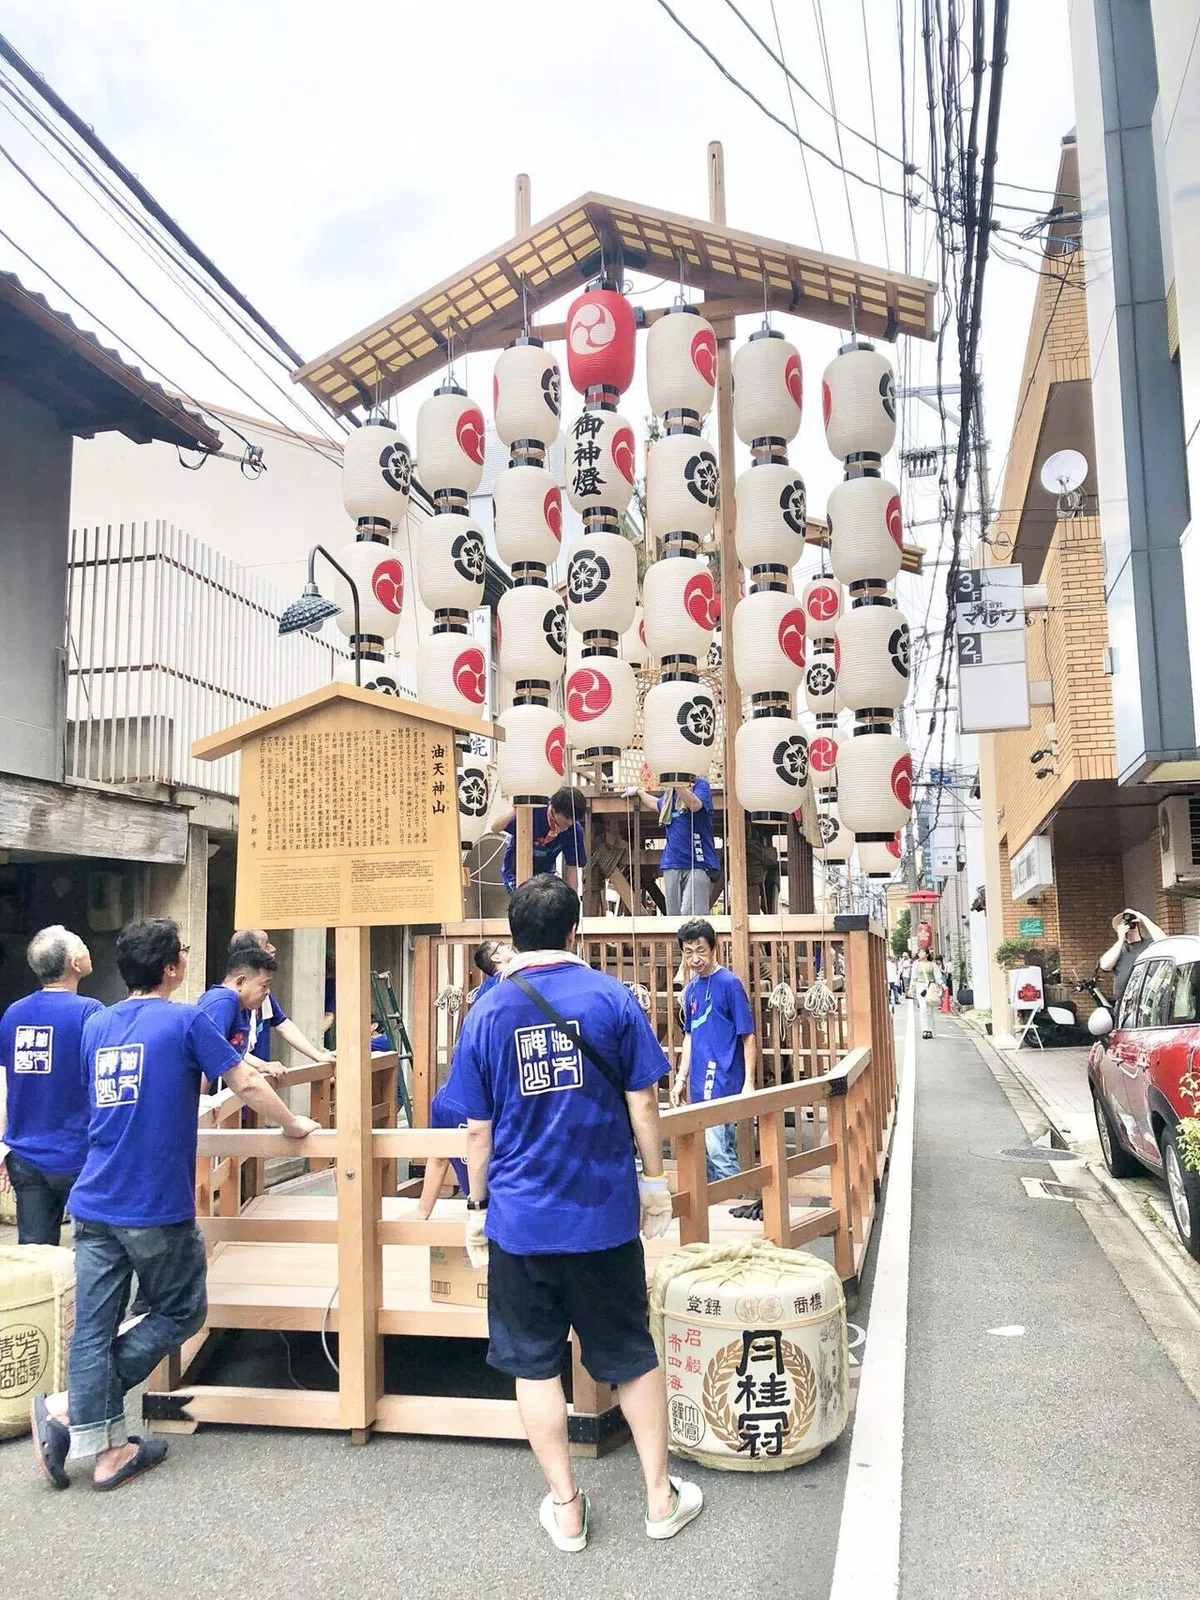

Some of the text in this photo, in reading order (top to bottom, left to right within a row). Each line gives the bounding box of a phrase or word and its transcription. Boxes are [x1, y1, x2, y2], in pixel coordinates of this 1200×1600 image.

[571, 411, 607, 497] 御神燈
[958, 572, 980, 601] 3F
[960, 636, 981, 663] 2F
[430, 744, 447, 815] 油天神山
[686, 1295, 722, 1316] 登録
[793, 1292, 823, 1315] 商標
[735, 1329, 791, 1458] 月桂冠
